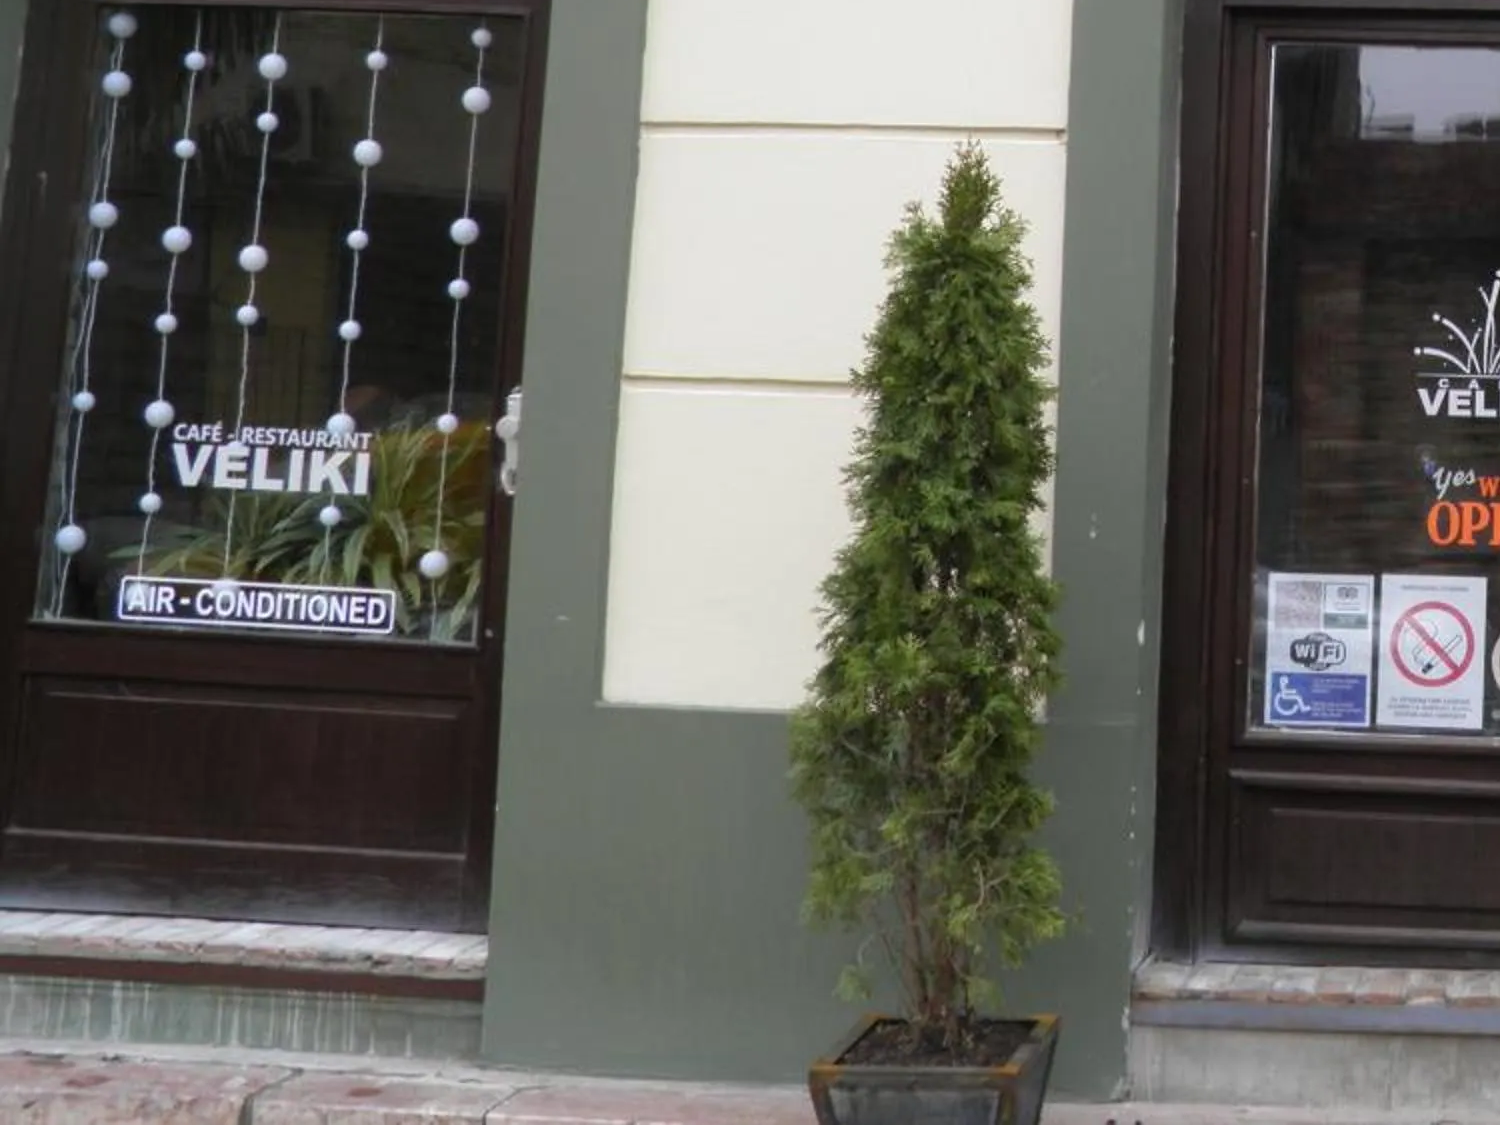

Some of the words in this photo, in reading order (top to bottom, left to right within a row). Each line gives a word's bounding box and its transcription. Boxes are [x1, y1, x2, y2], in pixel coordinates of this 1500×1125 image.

[173, 421, 223, 442] CAFÉ
[241, 426, 372, 449] RESTAURANT
[172, 443, 371, 495] VELIKI
